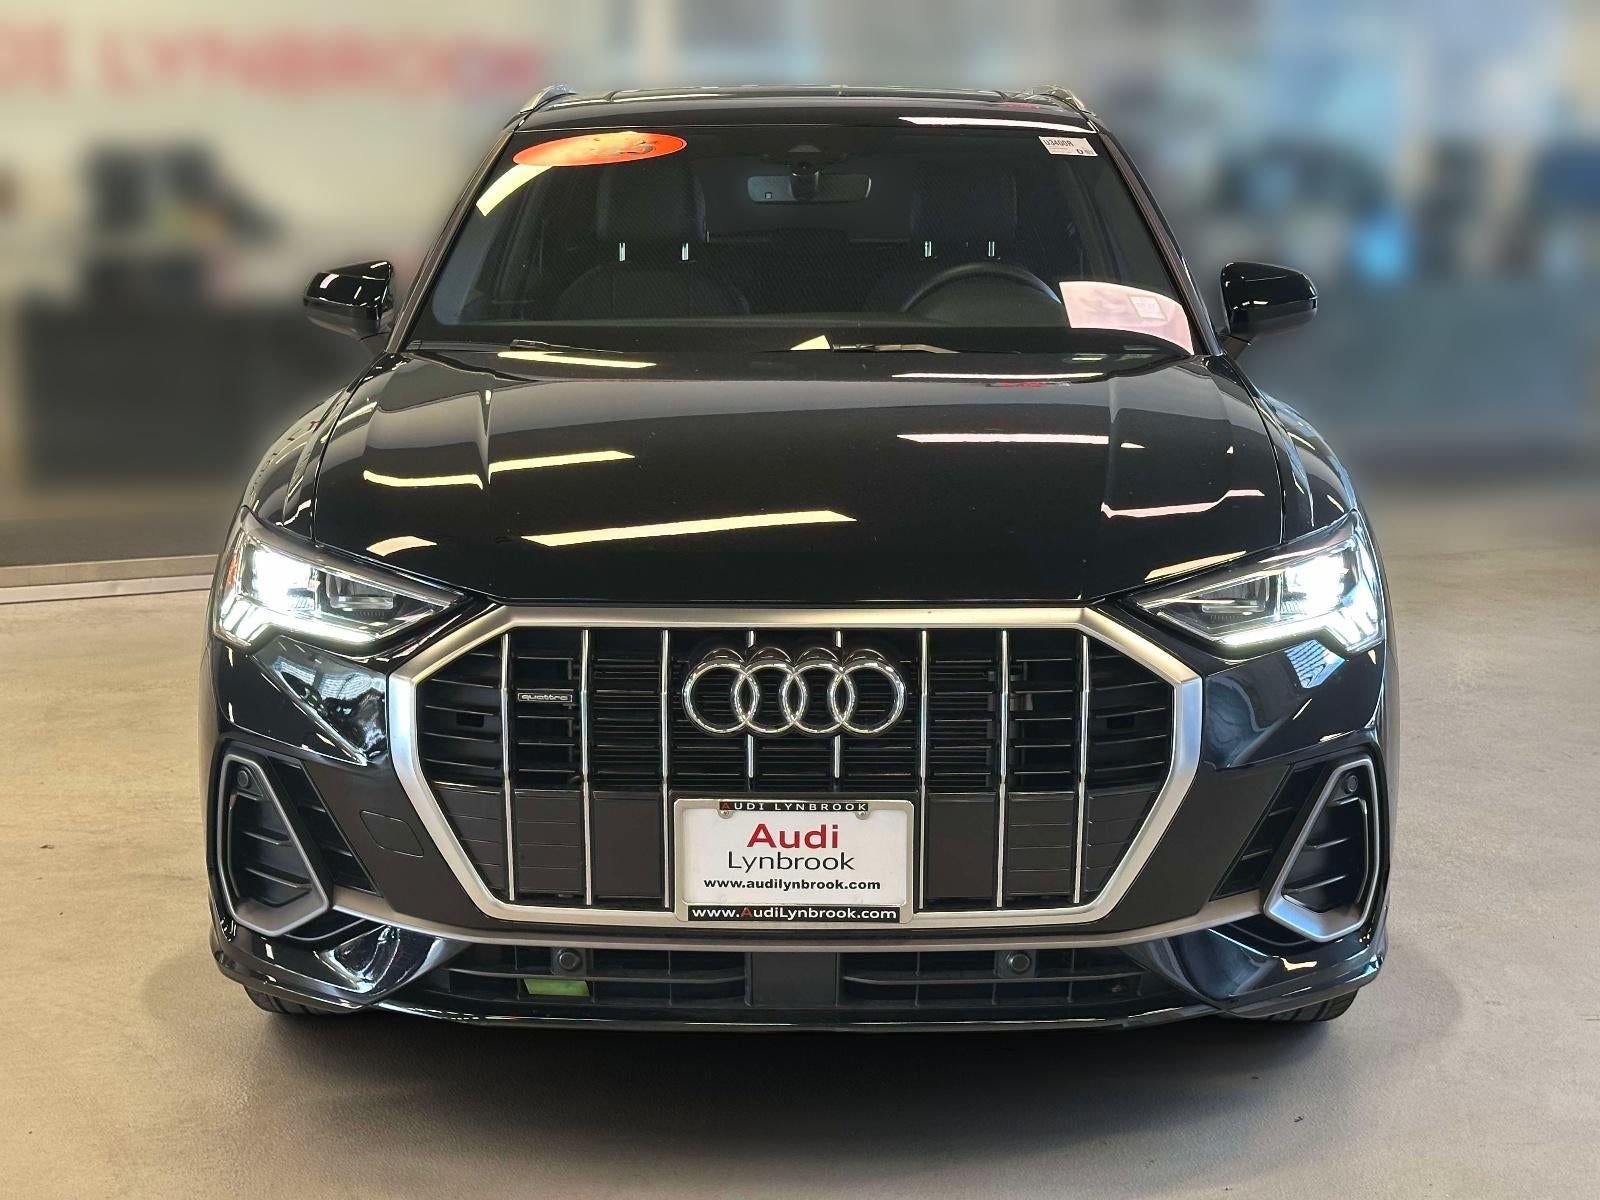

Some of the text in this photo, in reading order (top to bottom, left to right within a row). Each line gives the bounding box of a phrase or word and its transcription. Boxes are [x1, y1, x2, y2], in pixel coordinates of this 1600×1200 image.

[722, 802, 866, 811] AUDI LYNBROOK
[746, 823, 839, 849] Audi
[728, 851, 855, 873] Lynbrook
[703, 879, 881, 891] www.audilynbrook.com
[692, 907, 897, 920] www.AudiLynbrook.com
